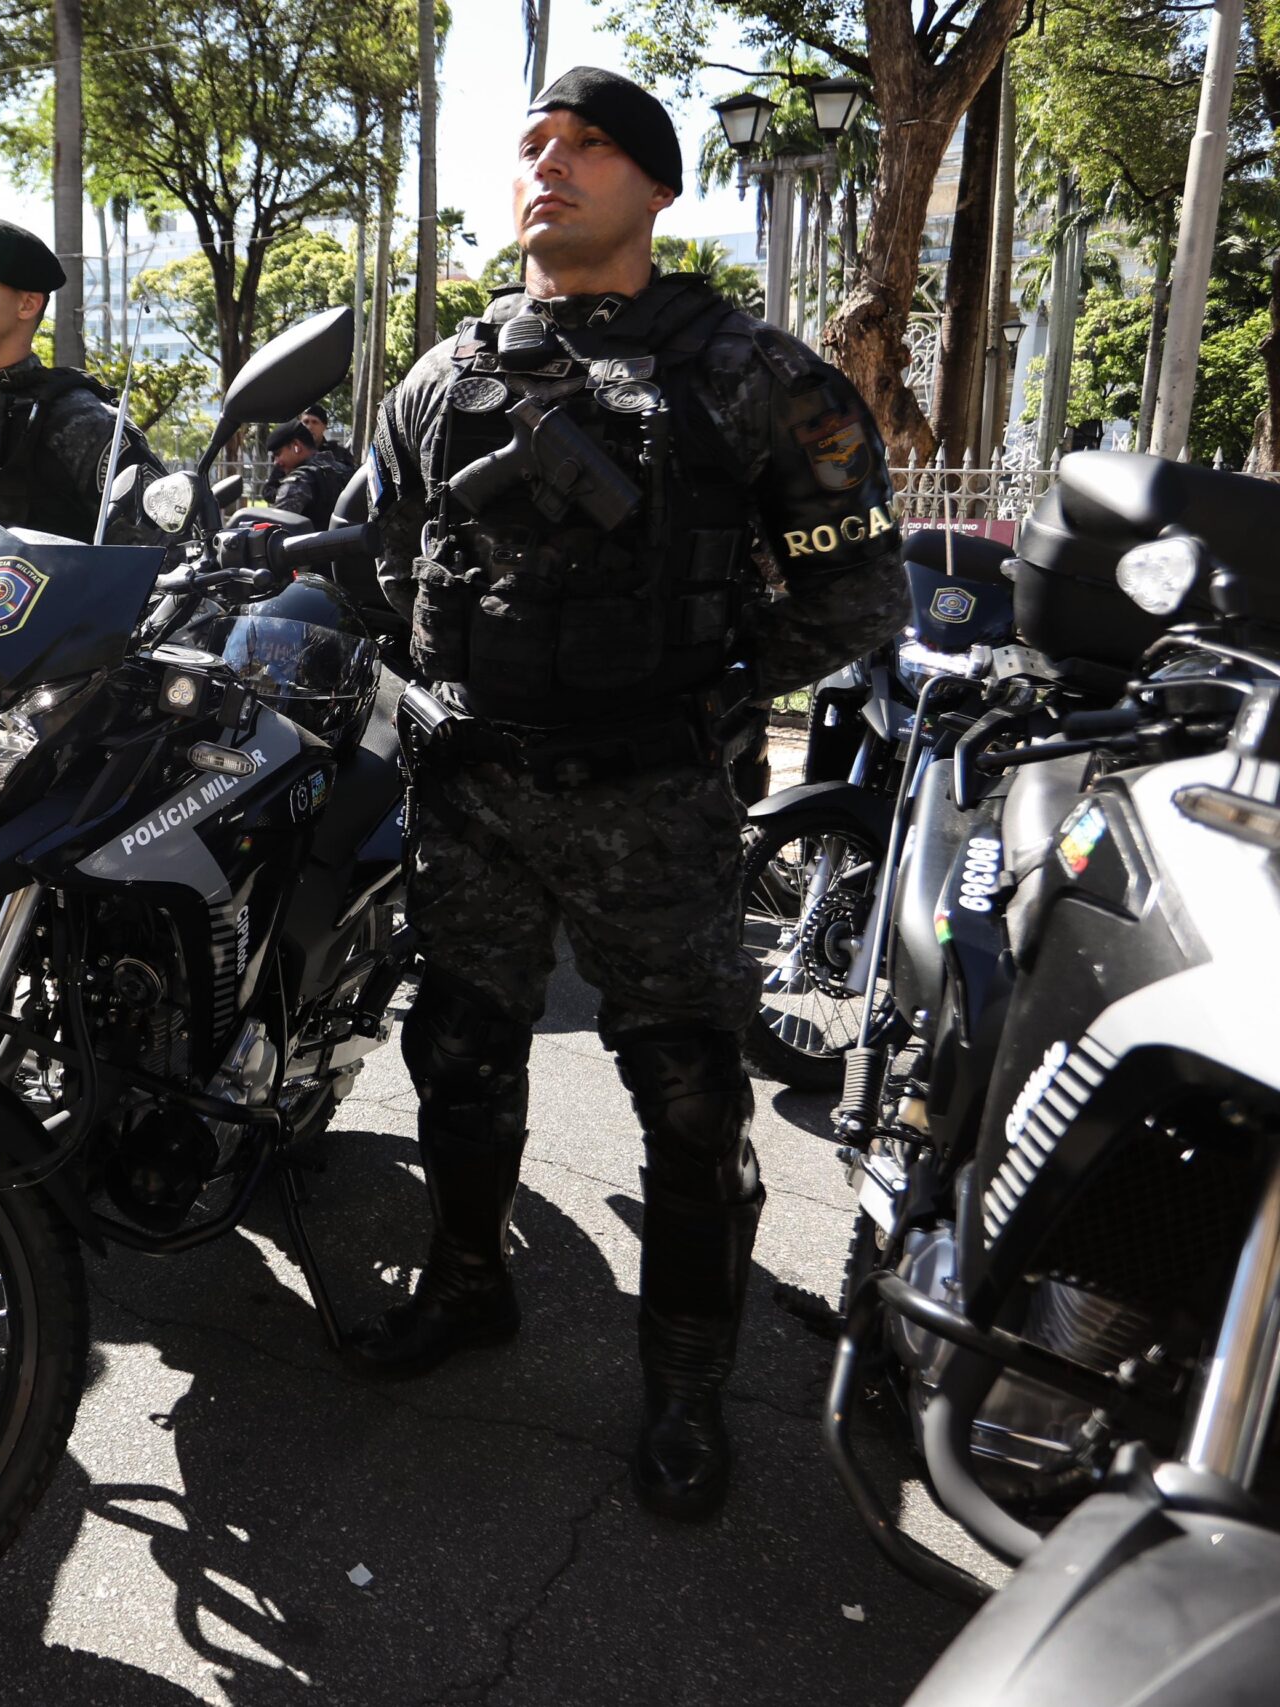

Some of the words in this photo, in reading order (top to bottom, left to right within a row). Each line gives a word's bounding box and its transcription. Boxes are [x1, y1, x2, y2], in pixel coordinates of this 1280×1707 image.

[15, 562, 42, 585] MILITAR
[121, 796, 201, 855] POLÍCIA
[199, 749, 267, 804] MILR
[958, 837, 1001, 912] 890369
[236, 905, 249, 975] CIPMoto
